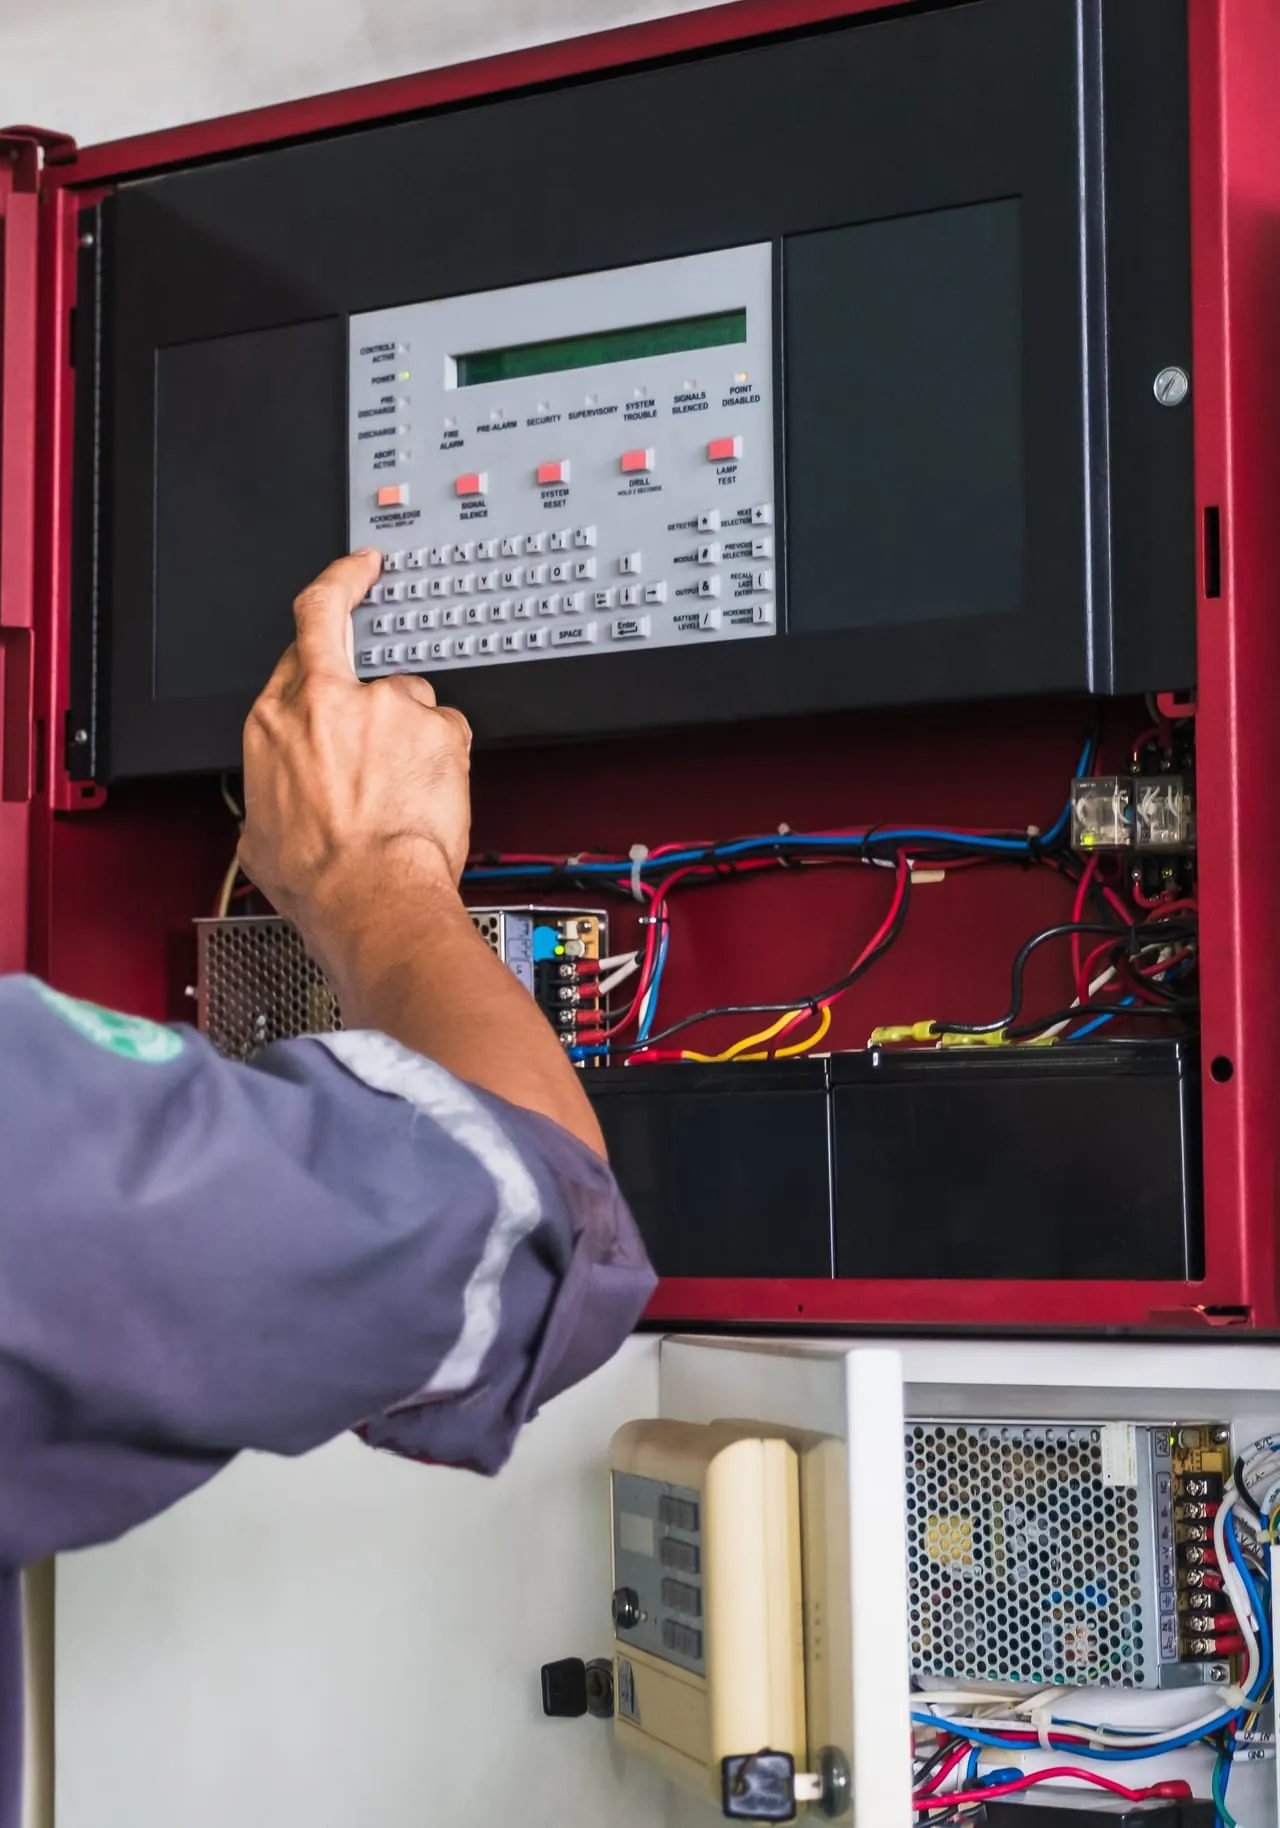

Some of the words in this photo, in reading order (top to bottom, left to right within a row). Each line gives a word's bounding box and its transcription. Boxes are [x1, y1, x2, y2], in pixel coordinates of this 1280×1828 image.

[360, 342, 395, 355] CONTROLS
[372, 353, 395, 363] ACTIVE
[371, 374, 395, 384] POWER
[730, 385, 752, 394] POINT
[674, 392, 706, 403] SIGNALS
[722, 395, 760, 407] DISABLED
[625, 400, 655, 411] SYSTEM
[672, 402, 708, 414] SILENCED
[358, 406, 395, 418] DISCHARGE
[569, 406, 618, 420] SUPERVISORY
[624, 410, 657, 421] TROUBLE
[527, 415, 561, 427] SECURITY
[477, 420, 518, 433] PRE-ALARM
[358, 427, 396, 440] DISCHARGE
[444, 430, 459, 439] FIRE
[440, 440, 464, 450] ALARM
[374, 449, 395, 459] ABORT
[373, 460, 395, 469] ACTIVE
[716, 466, 738, 475] LAMP
[629, 478, 650, 487] DRILL
[718, 476, 736, 485] TEST
[541, 489, 570, 499] SYSTEM
[461, 500, 486, 510] SIGNAL
[544, 500, 567, 509] RESET
[369, 510, 421, 523] ACKNOWLEDGE
[460, 510, 488, 520] SILENCE
[554, 567, 561, 577] O
[617, 620, 636, 629] Enter
[559, 628, 583, 639] SPACE
